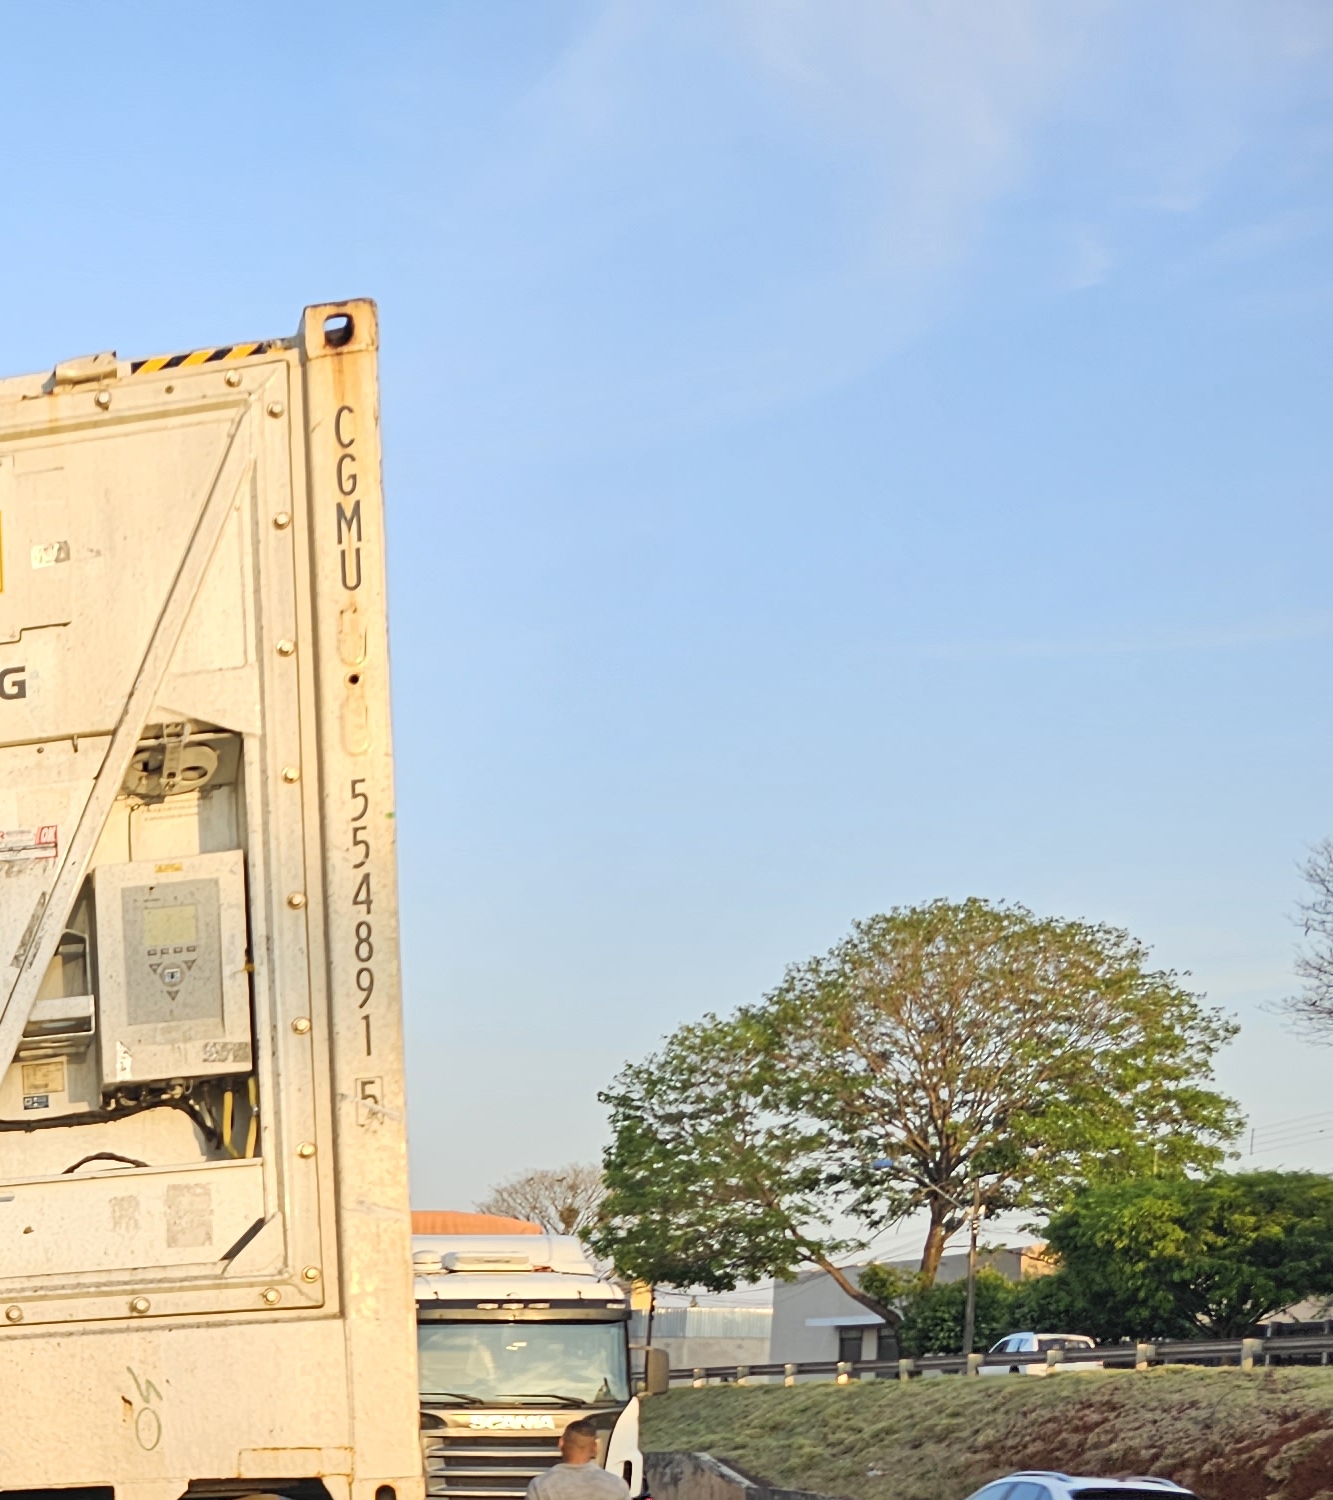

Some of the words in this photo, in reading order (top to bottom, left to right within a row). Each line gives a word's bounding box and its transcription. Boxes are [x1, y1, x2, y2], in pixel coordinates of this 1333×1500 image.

[333, 405, 364, 593] CGMU
[348, 777, 375, 1058] 554891
[469, 1414, 556, 1431] SCANIA
